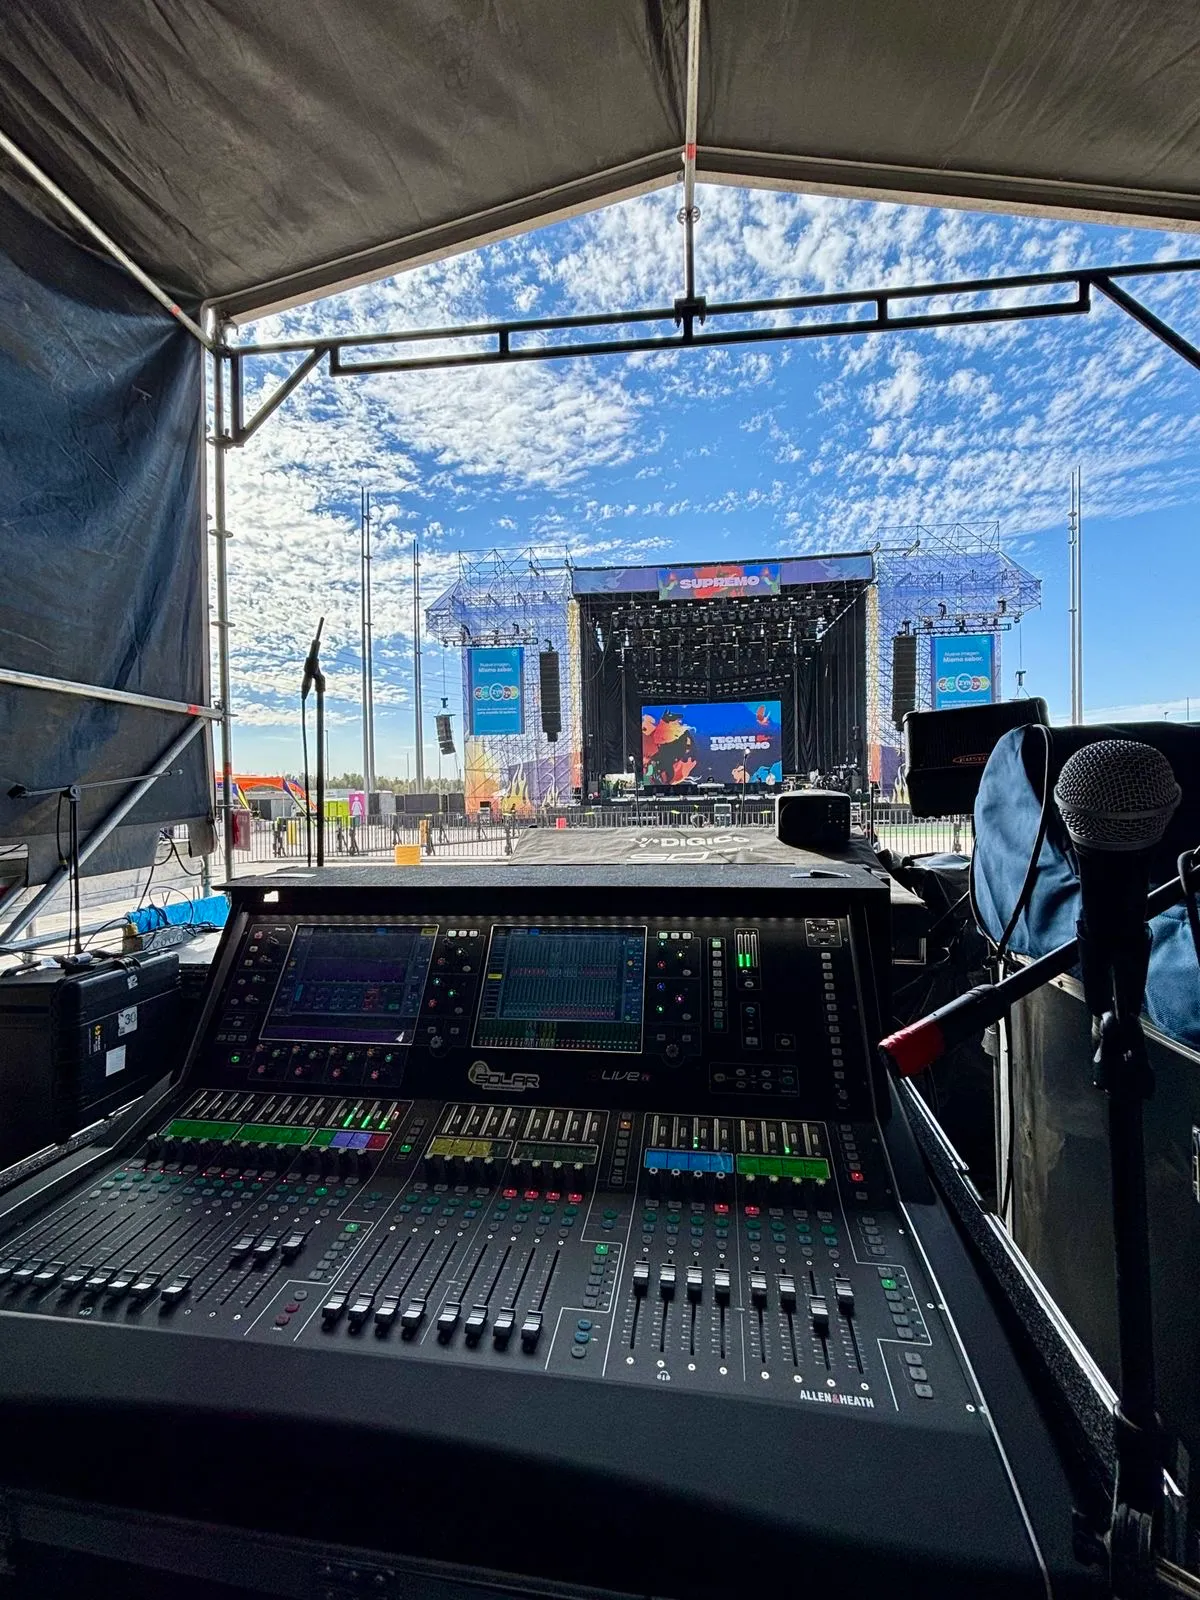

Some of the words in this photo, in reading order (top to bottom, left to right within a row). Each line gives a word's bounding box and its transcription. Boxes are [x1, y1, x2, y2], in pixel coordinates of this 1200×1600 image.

[679, 575, 760, 589] SUPREMO
[710, 735, 756, 744] TECATE
[710, 741, 771, 751] SUPREMO
[475, 1073, 538, 1088] SOLAR
[800, 1390, 874, 1408] ALLEN&HEATH
